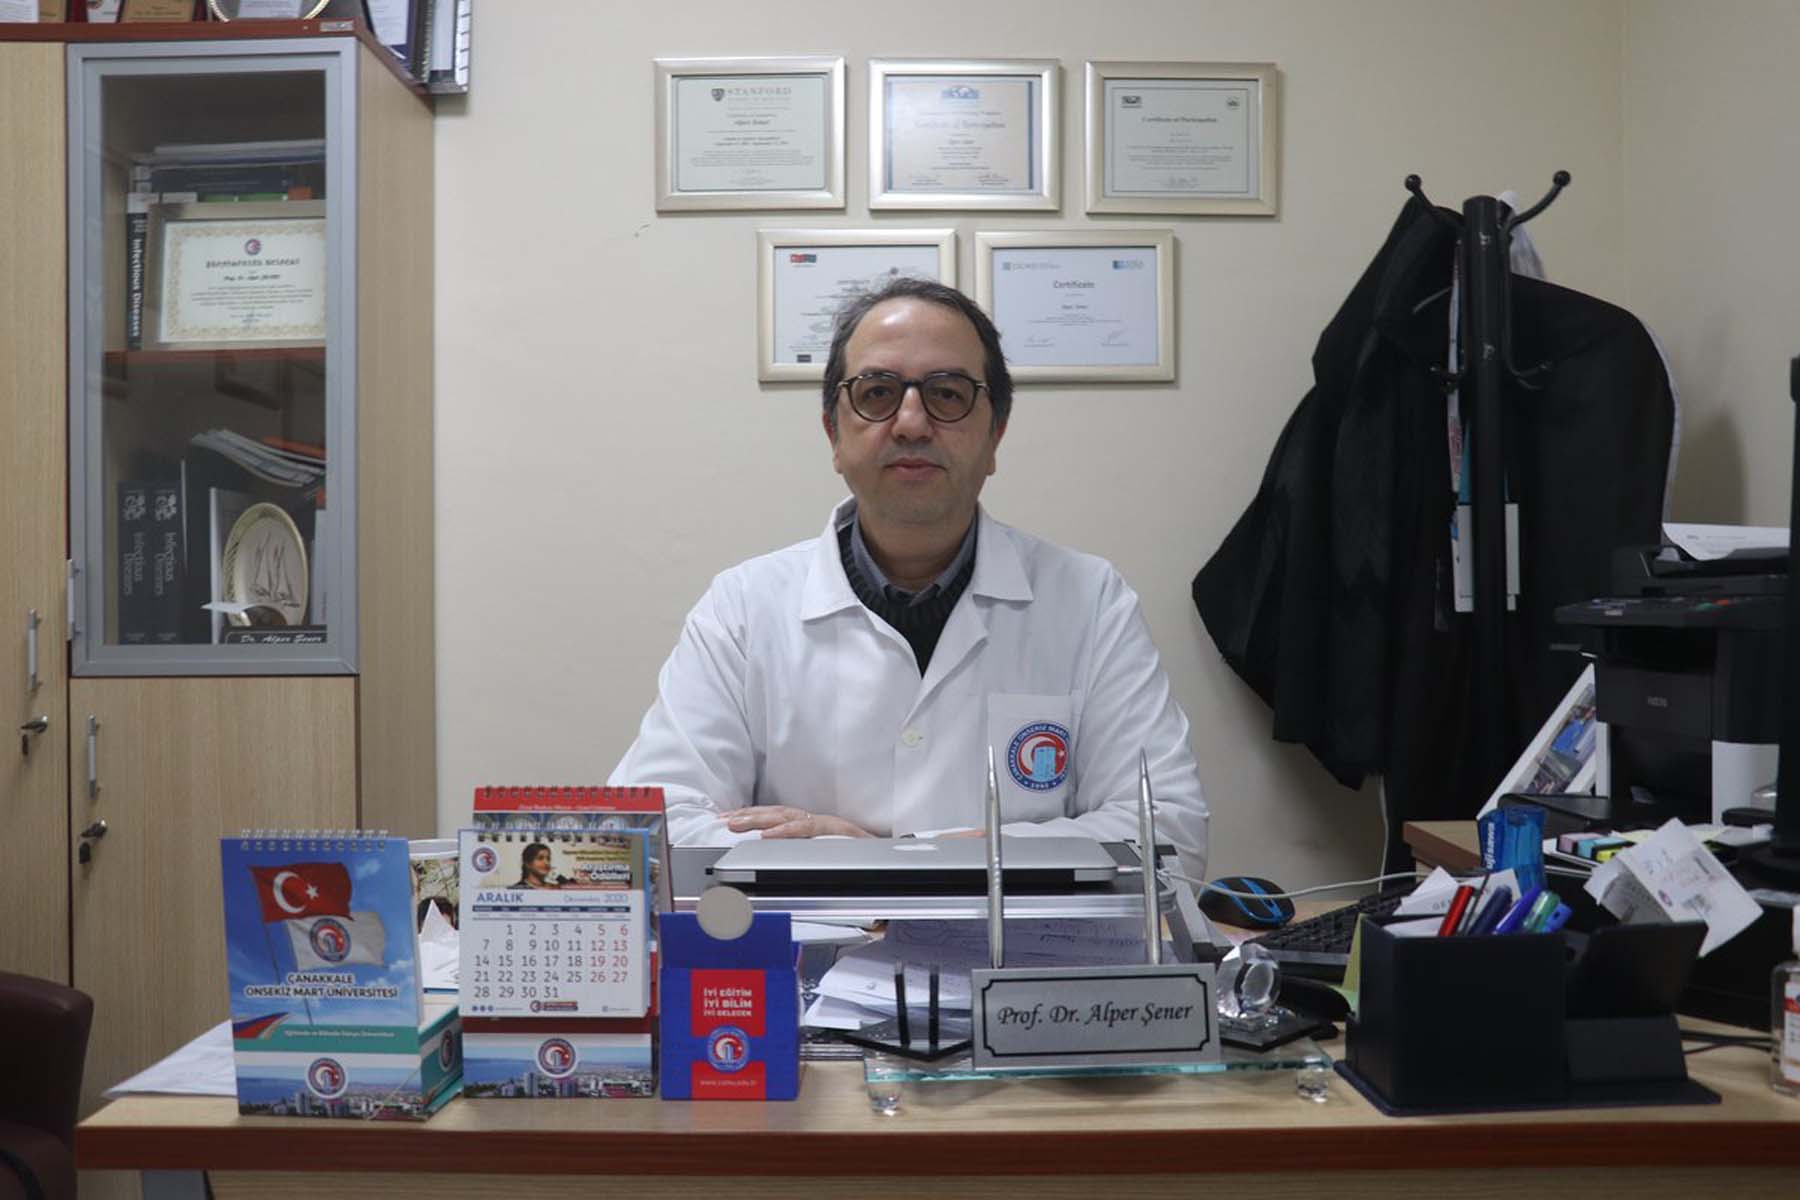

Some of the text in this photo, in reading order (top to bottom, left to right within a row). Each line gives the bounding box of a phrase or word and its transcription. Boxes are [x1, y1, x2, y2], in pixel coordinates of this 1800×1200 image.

[132, 239, 142, 290] Infectious
[1053, 280, 1095, 289] Certificate
[132, 293, 142, 337] Diseases
[477, 893, 524, 903] ARALIK
[507, 924, 628, 936] 1 2 3 4 5 6
[483, 940, 628, 951] 7 8 9 10 11 12 13
[475, 955, 628, 967] 14 15 16 17 18 19 20
[287, 973, 353, 984] ÇANAKKALE
[474, 971, 628, 983] 21 22 23 24 25 26 27
[246, 986, 398, 998] ONSEKİZ MART ÜNİVERSİTESİ
[474, 986, 559, 998] 28 29 30 31
[704, 986, 752, 997] İYİ EĞİTİM
[704, 998, 752, 1008] İYİ BİLİM
[998, 1002, 1193, 1030] Prof. Dr. Alper Şener
